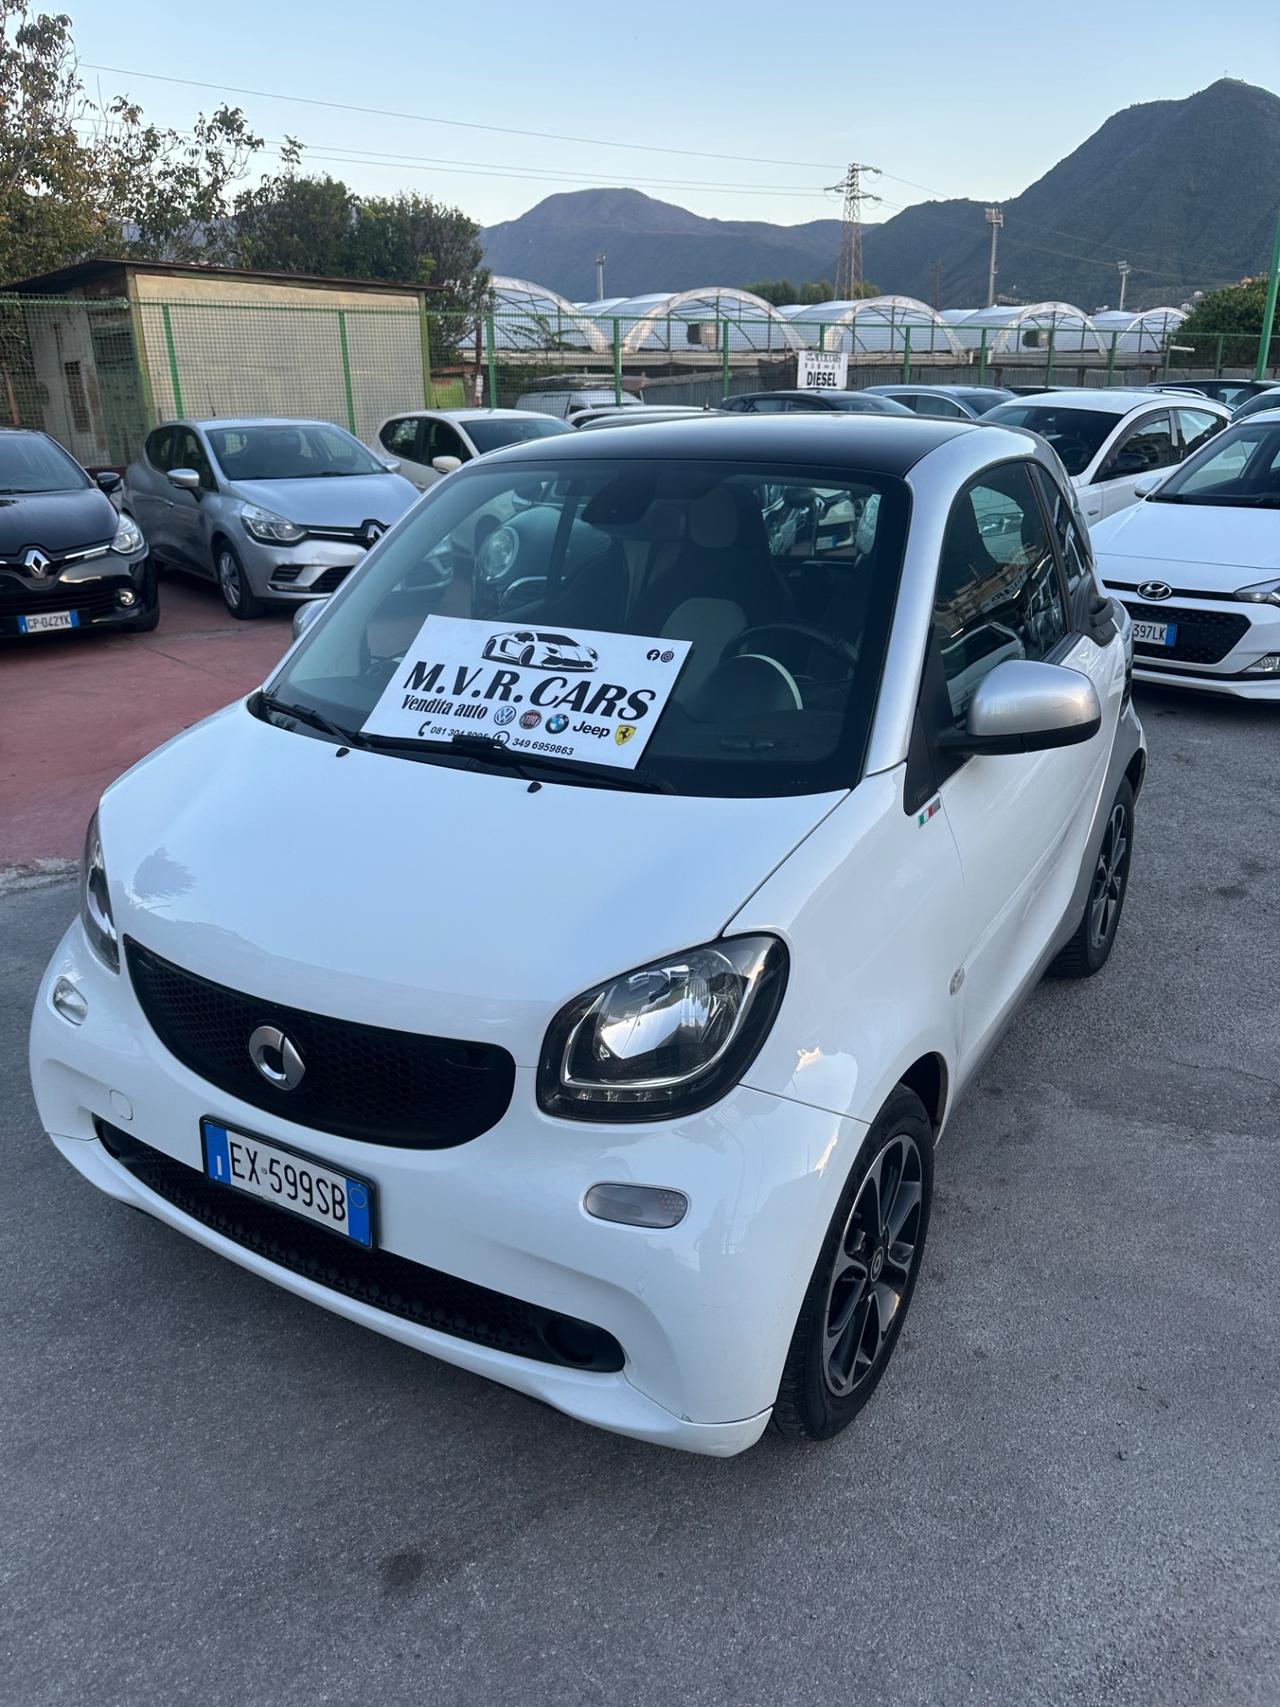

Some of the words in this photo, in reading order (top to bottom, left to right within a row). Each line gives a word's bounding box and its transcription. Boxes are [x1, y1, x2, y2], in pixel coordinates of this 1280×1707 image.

[807, 371, 837, 387] DIESEL
[401, 694, 454, 715] Vendita
[453, 703, 489, 720] auto
[430, 726, 447, 736] 081
[572, 721, 611, 739] Jeep
[512, 738, 530, 748] 349
[531, 741, 574, 756] 6959863
